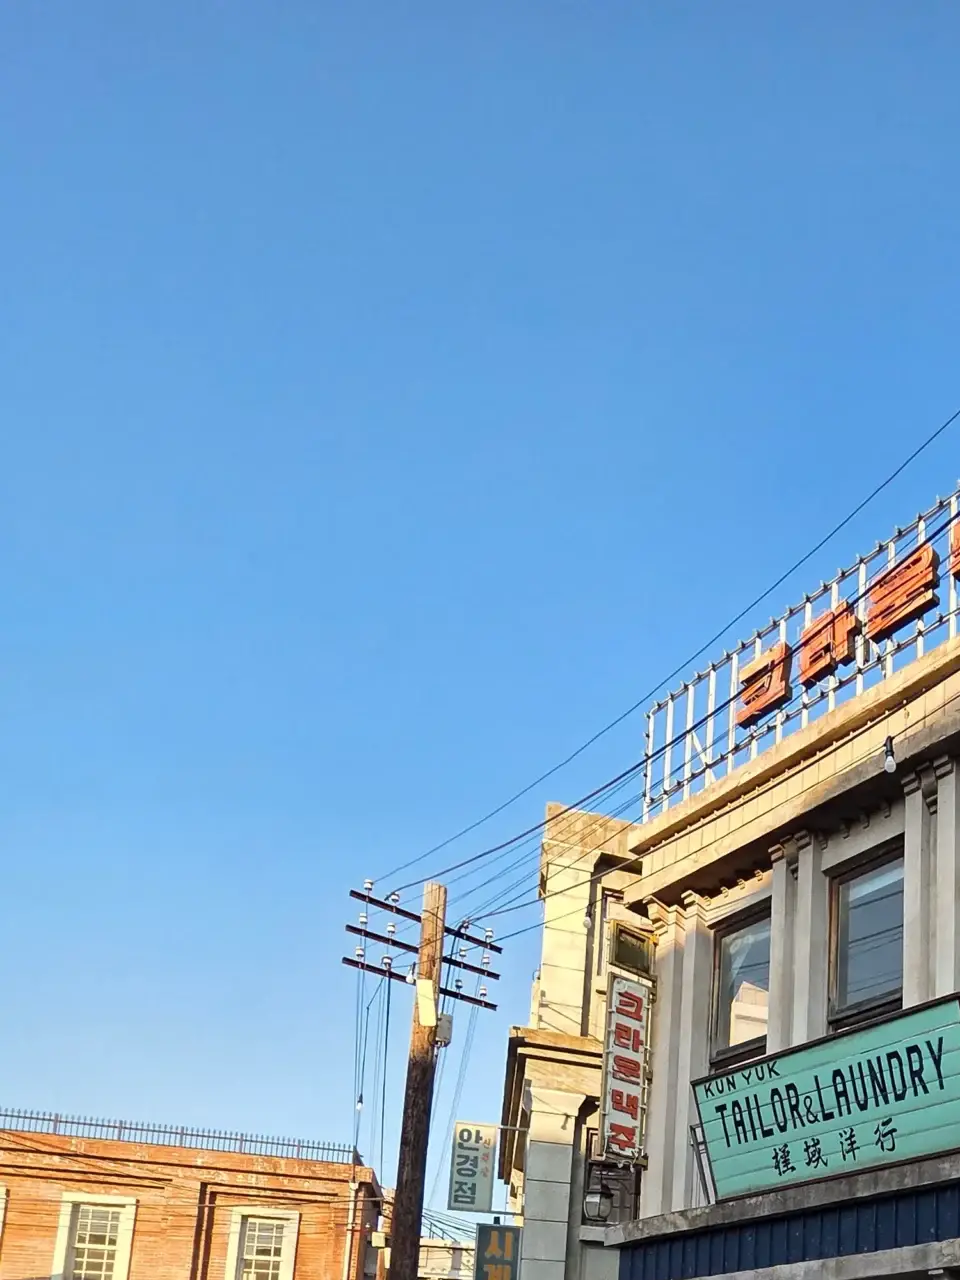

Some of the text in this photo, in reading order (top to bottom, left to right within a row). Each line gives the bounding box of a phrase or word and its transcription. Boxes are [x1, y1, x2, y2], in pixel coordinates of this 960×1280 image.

[703, 1060, 781, 1098] KUN YUK
[453, 1128, 483, 1206] 안경점
